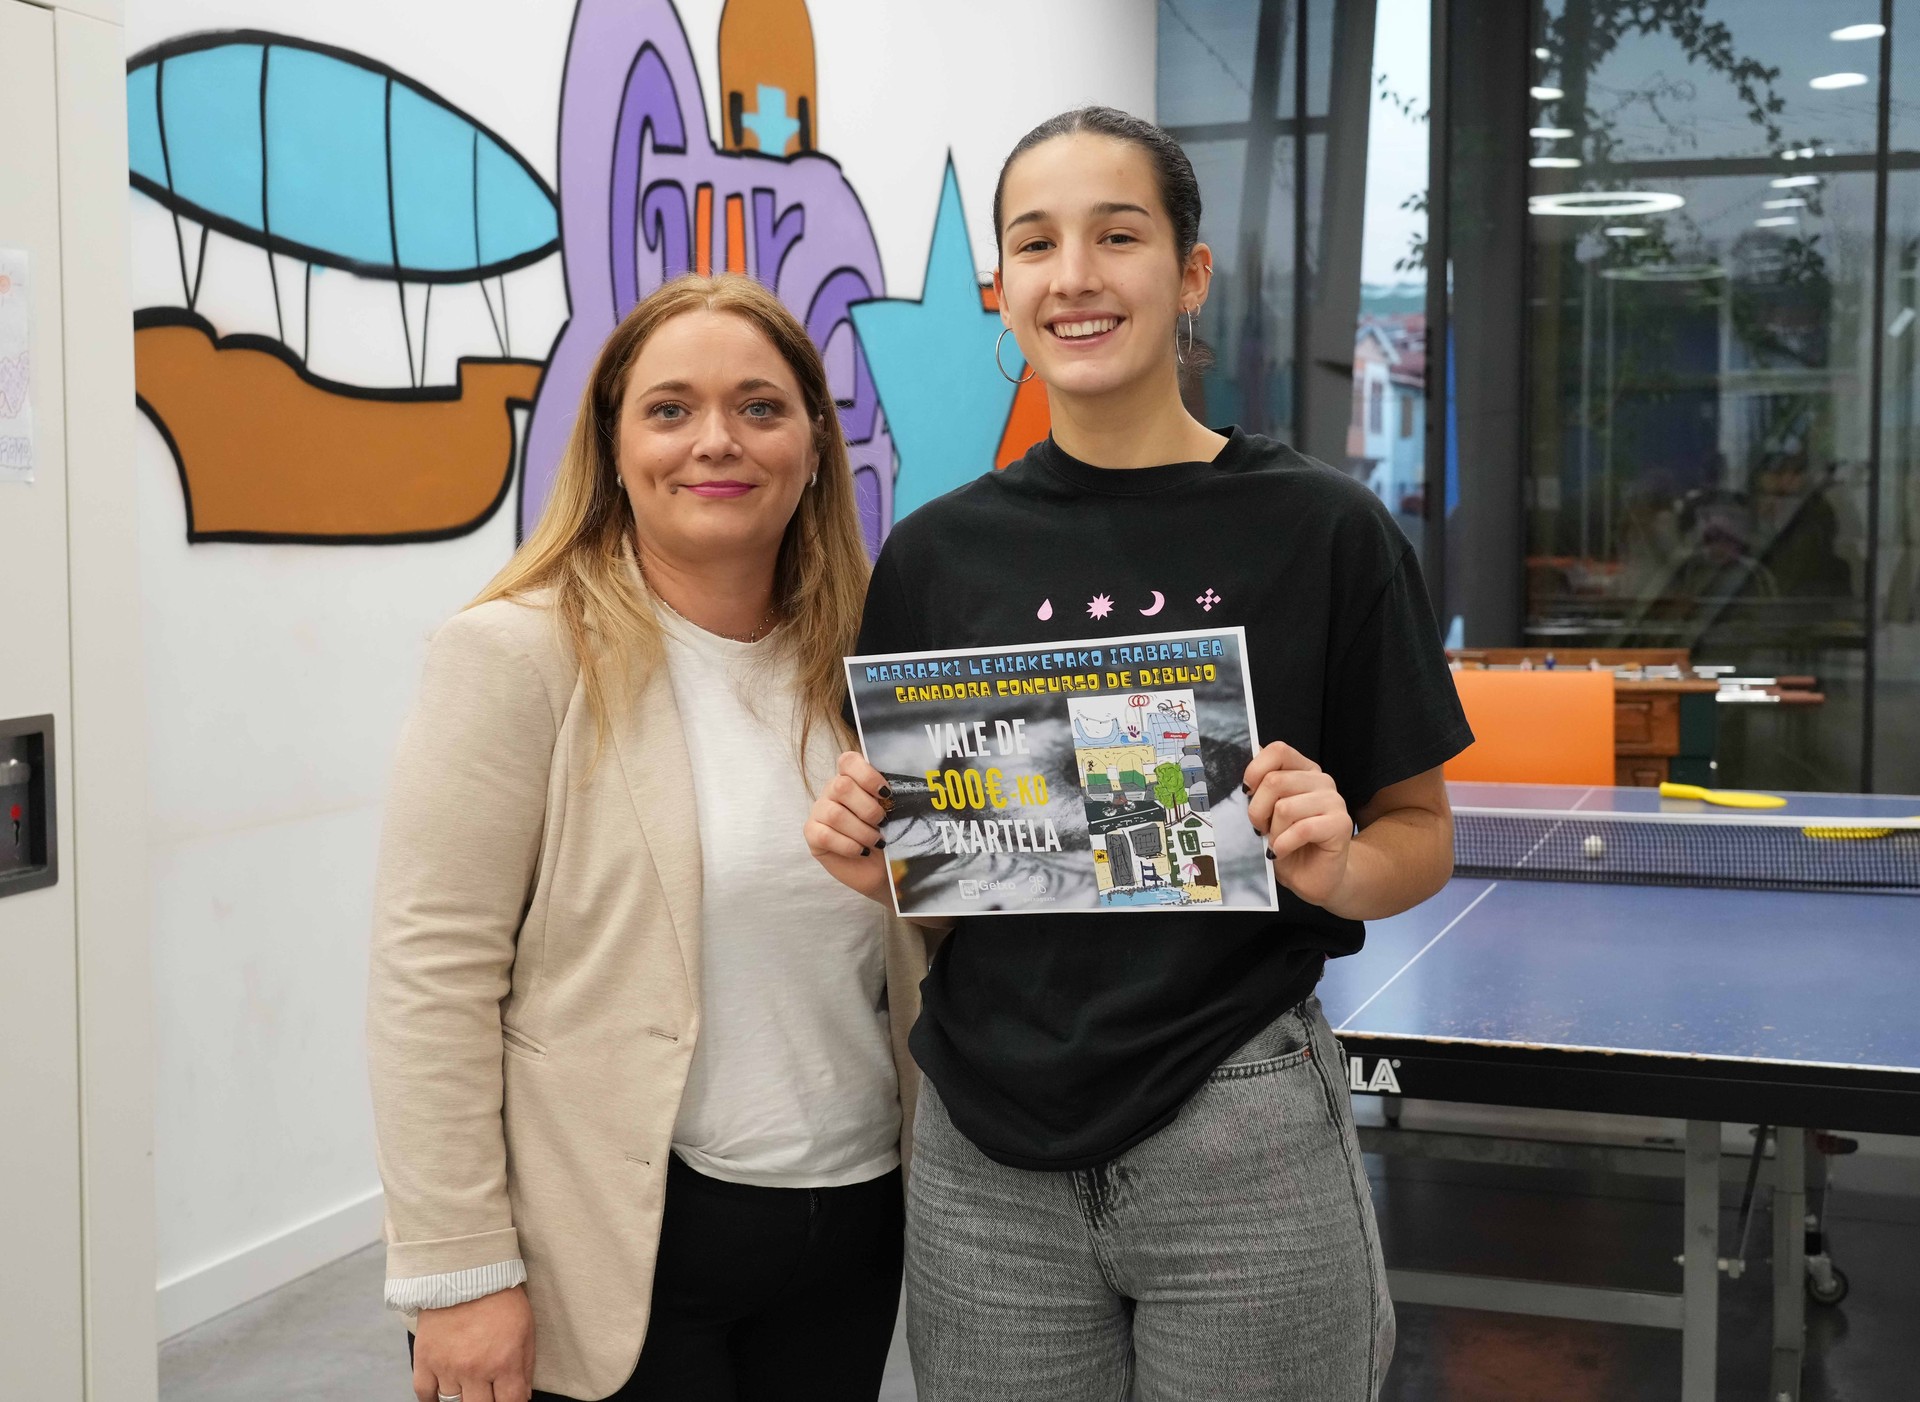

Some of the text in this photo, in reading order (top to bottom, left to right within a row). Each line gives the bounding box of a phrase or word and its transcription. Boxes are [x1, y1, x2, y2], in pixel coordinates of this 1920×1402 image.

[865, 639, 1224, 683] MARRAZKI LEHIAKETAKO IRABAZLEA
[895, 663, 1216, 703] GANADORA CONCURSO DE DIBUJO
[924, 719, 1030, 758] VALE DE
[935, 818, 1062, 854] TXARTELA
[979, 880, 1016, 891] Getxo
[1347, 1056, 1401, 1093] LA
